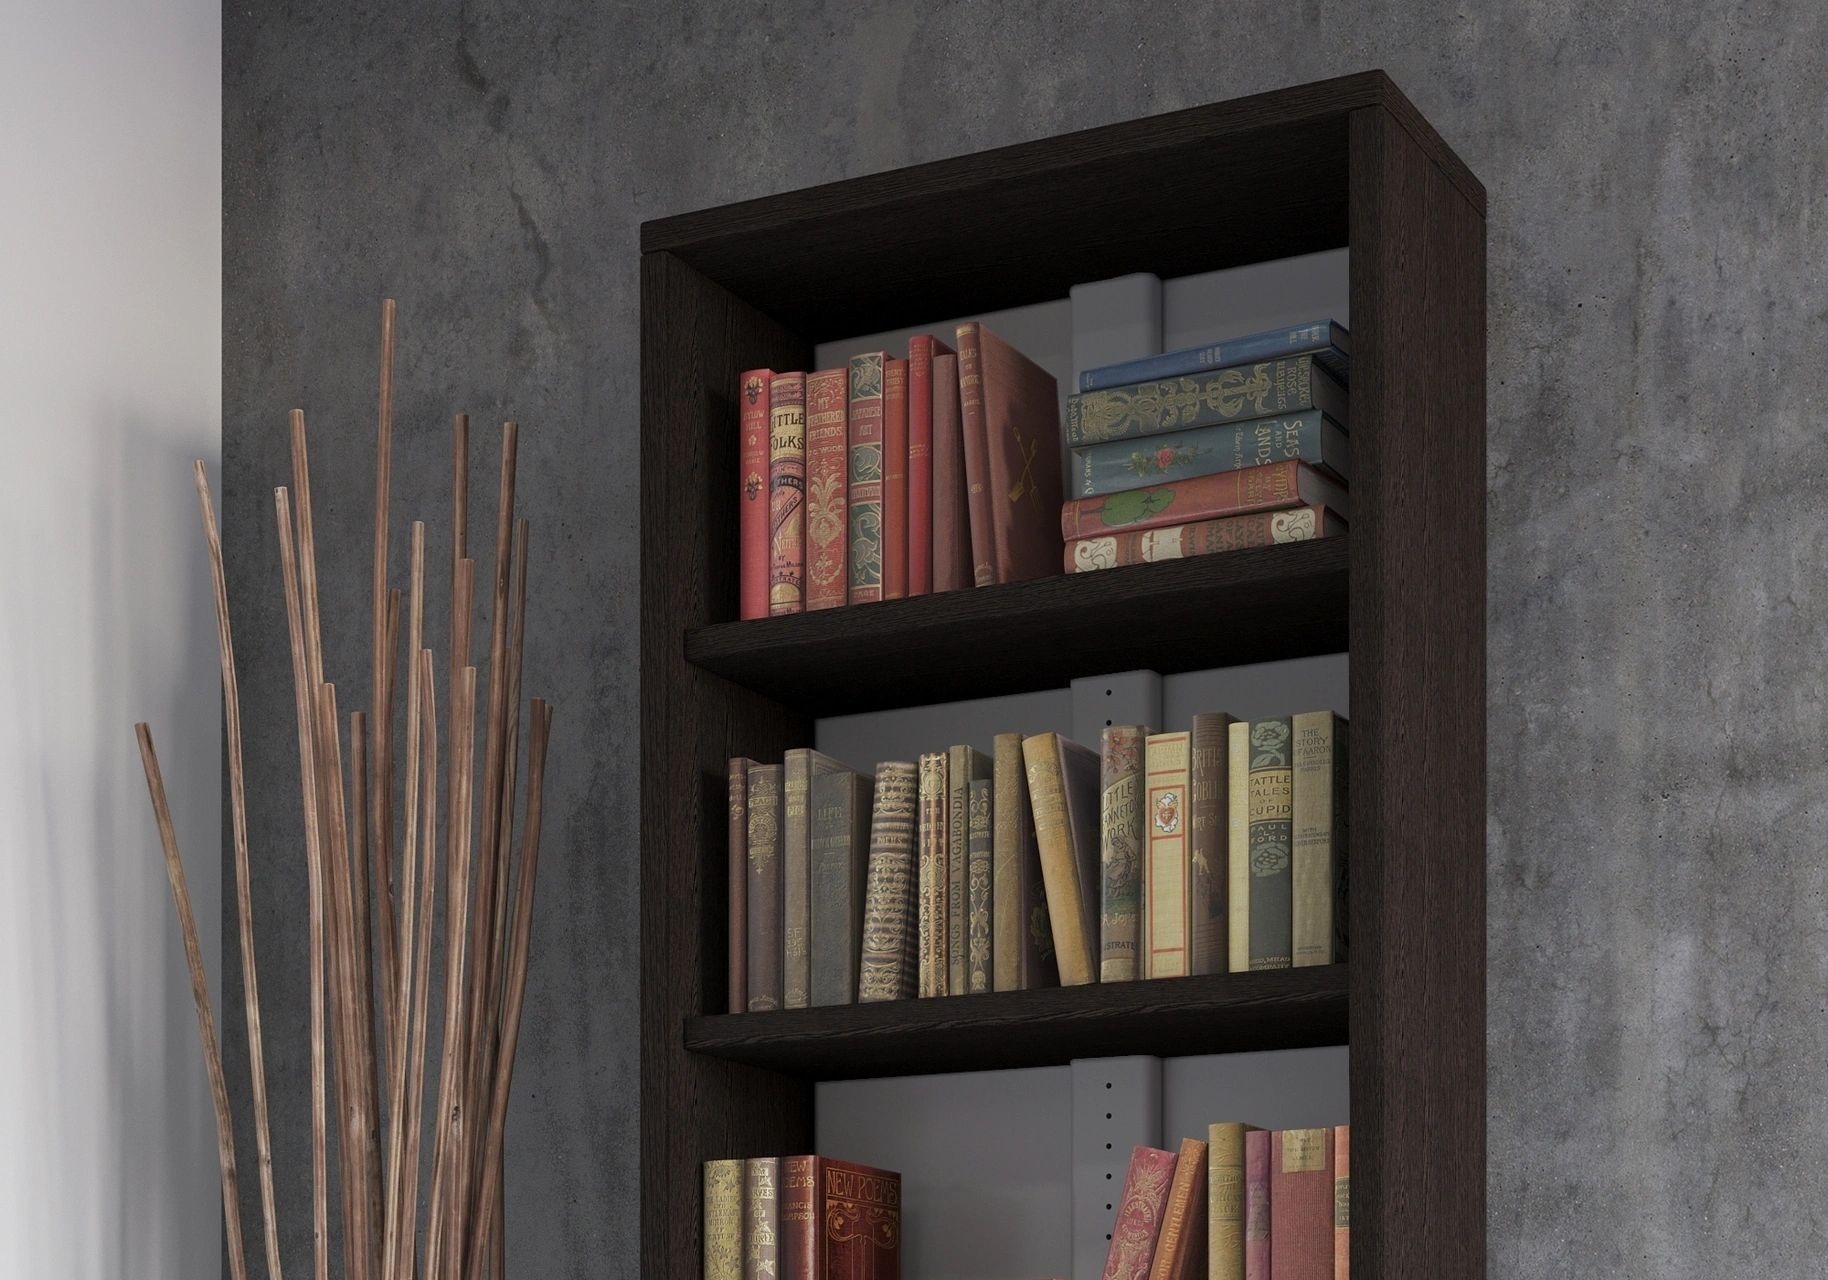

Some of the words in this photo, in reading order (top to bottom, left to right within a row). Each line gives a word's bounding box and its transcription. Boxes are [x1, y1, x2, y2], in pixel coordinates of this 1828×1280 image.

[1255, 421, 1277, 465] LANDS
[1275, 430, 1283, 448] AND
[1283, 420, 1303, 457] SEAS
[1296, 736, 1328, 747] STORY
[1301, 728, 1320, 737] THE
[1249, 775, 1291, 787] TATTLE
[1250, 786, 1290, 798] TALES
[1249, 804, 1291, 817] CUPID
[951, 787, 963, 873] VAGABONDIA
[1250, 824, 1288, 835] PAUL
[951, 880, 962, 918] FROM
[951, 924, 963, 965] SONGS
[827, 1170, 854, 1198] NEW
[858, 1176, 898, 1205] POEMS
[1166, 1182, 1191, 1251] GENTLEMEN
